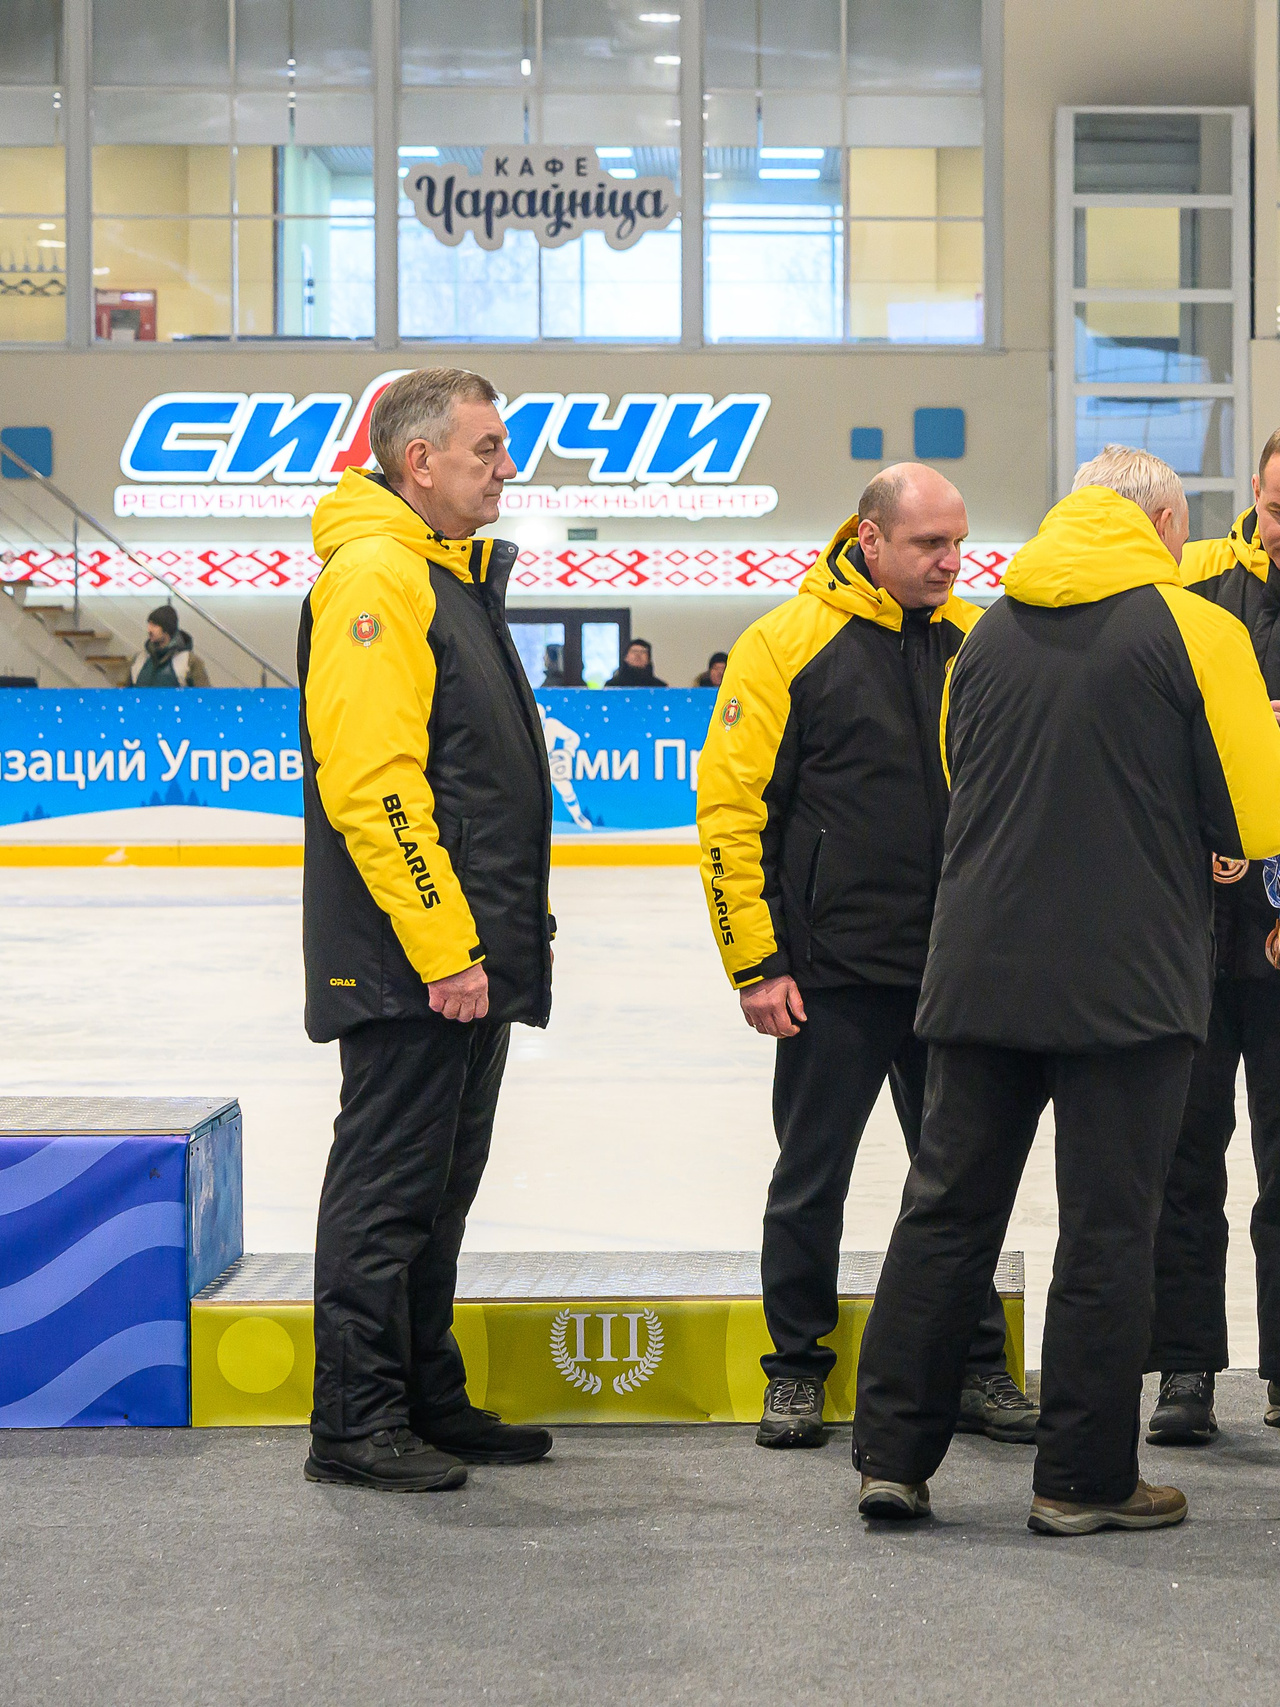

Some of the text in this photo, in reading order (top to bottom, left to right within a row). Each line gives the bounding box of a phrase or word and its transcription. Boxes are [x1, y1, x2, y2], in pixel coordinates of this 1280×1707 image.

[495, 157, 588, 177] КАФЕ
[415, 175, 668, 240] Чараўніца
[497, 491, 669, 510] ОЛЫЖНЫЙ
[679, 494, 770, 512] ЦЕНТР
[0, 739, 146, 790] заций
[382, 793, 441, 910] BELARUS
[710, 847, 735, 946] BELARUS
[329, 978, 357, 987] ORAZ
[569, 1313, 645, 1362] III
